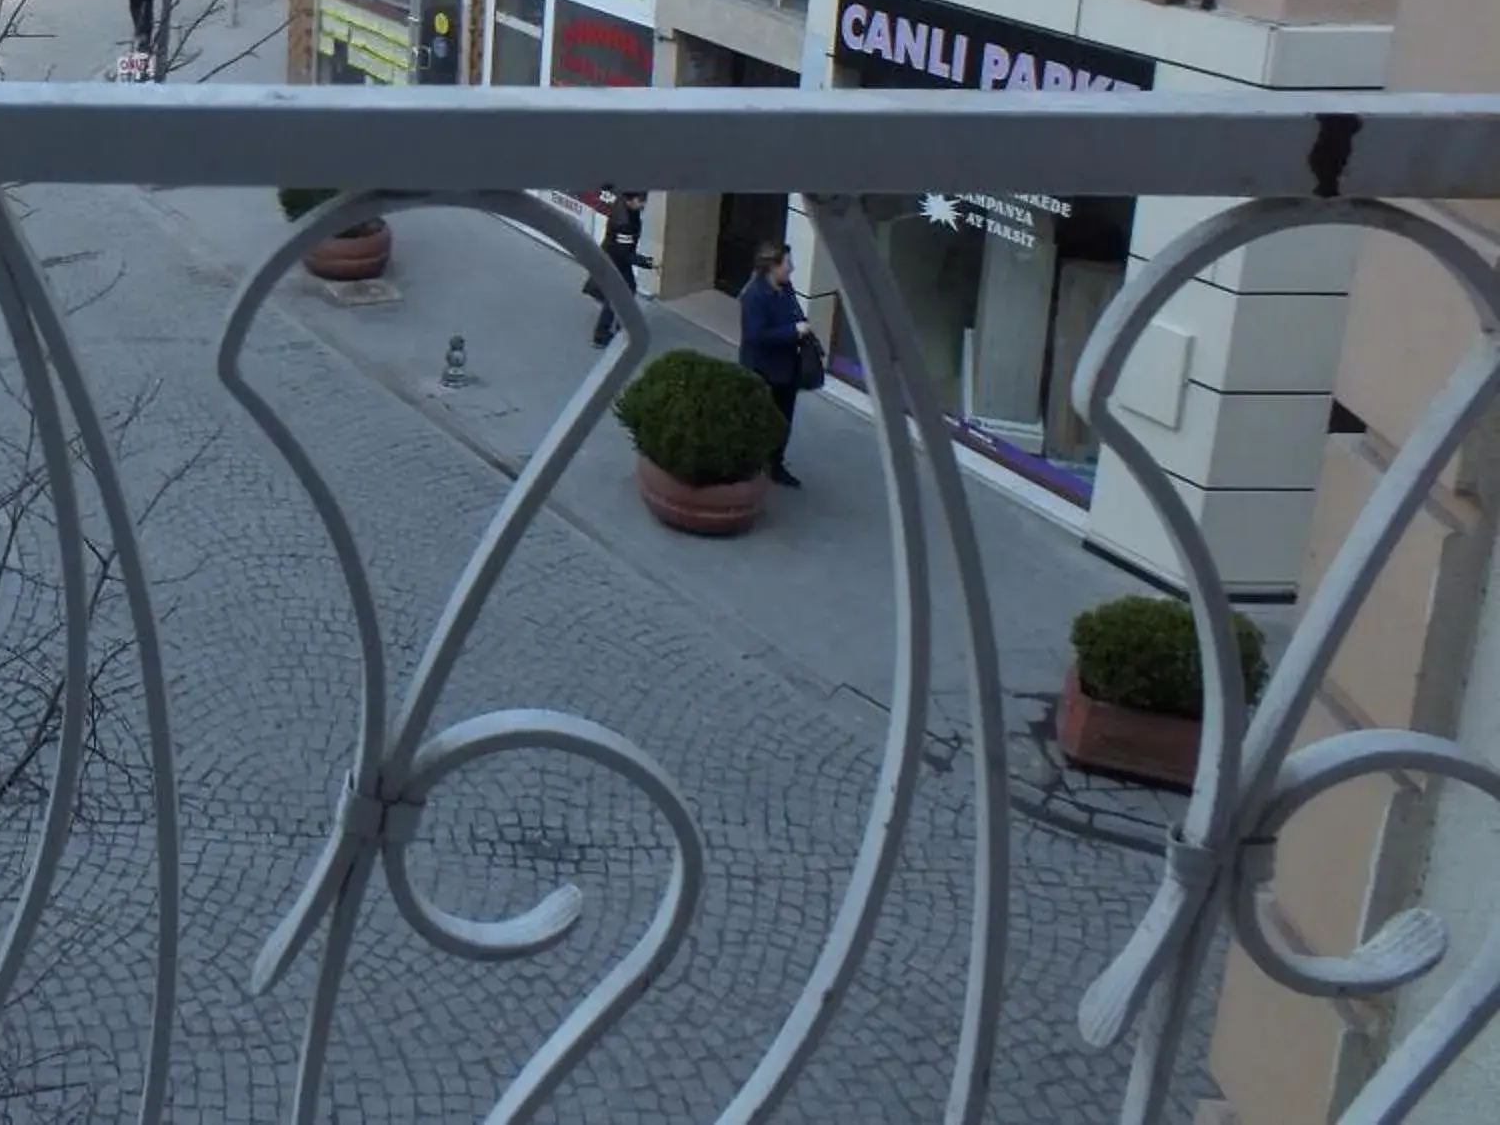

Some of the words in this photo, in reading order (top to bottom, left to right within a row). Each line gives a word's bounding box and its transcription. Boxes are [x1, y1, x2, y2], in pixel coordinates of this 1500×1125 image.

[841, 3, 969, 84] CANLI
[980, 42, 1142, 91] PAR
[955, 193, 1033, 226] AMPANYA
